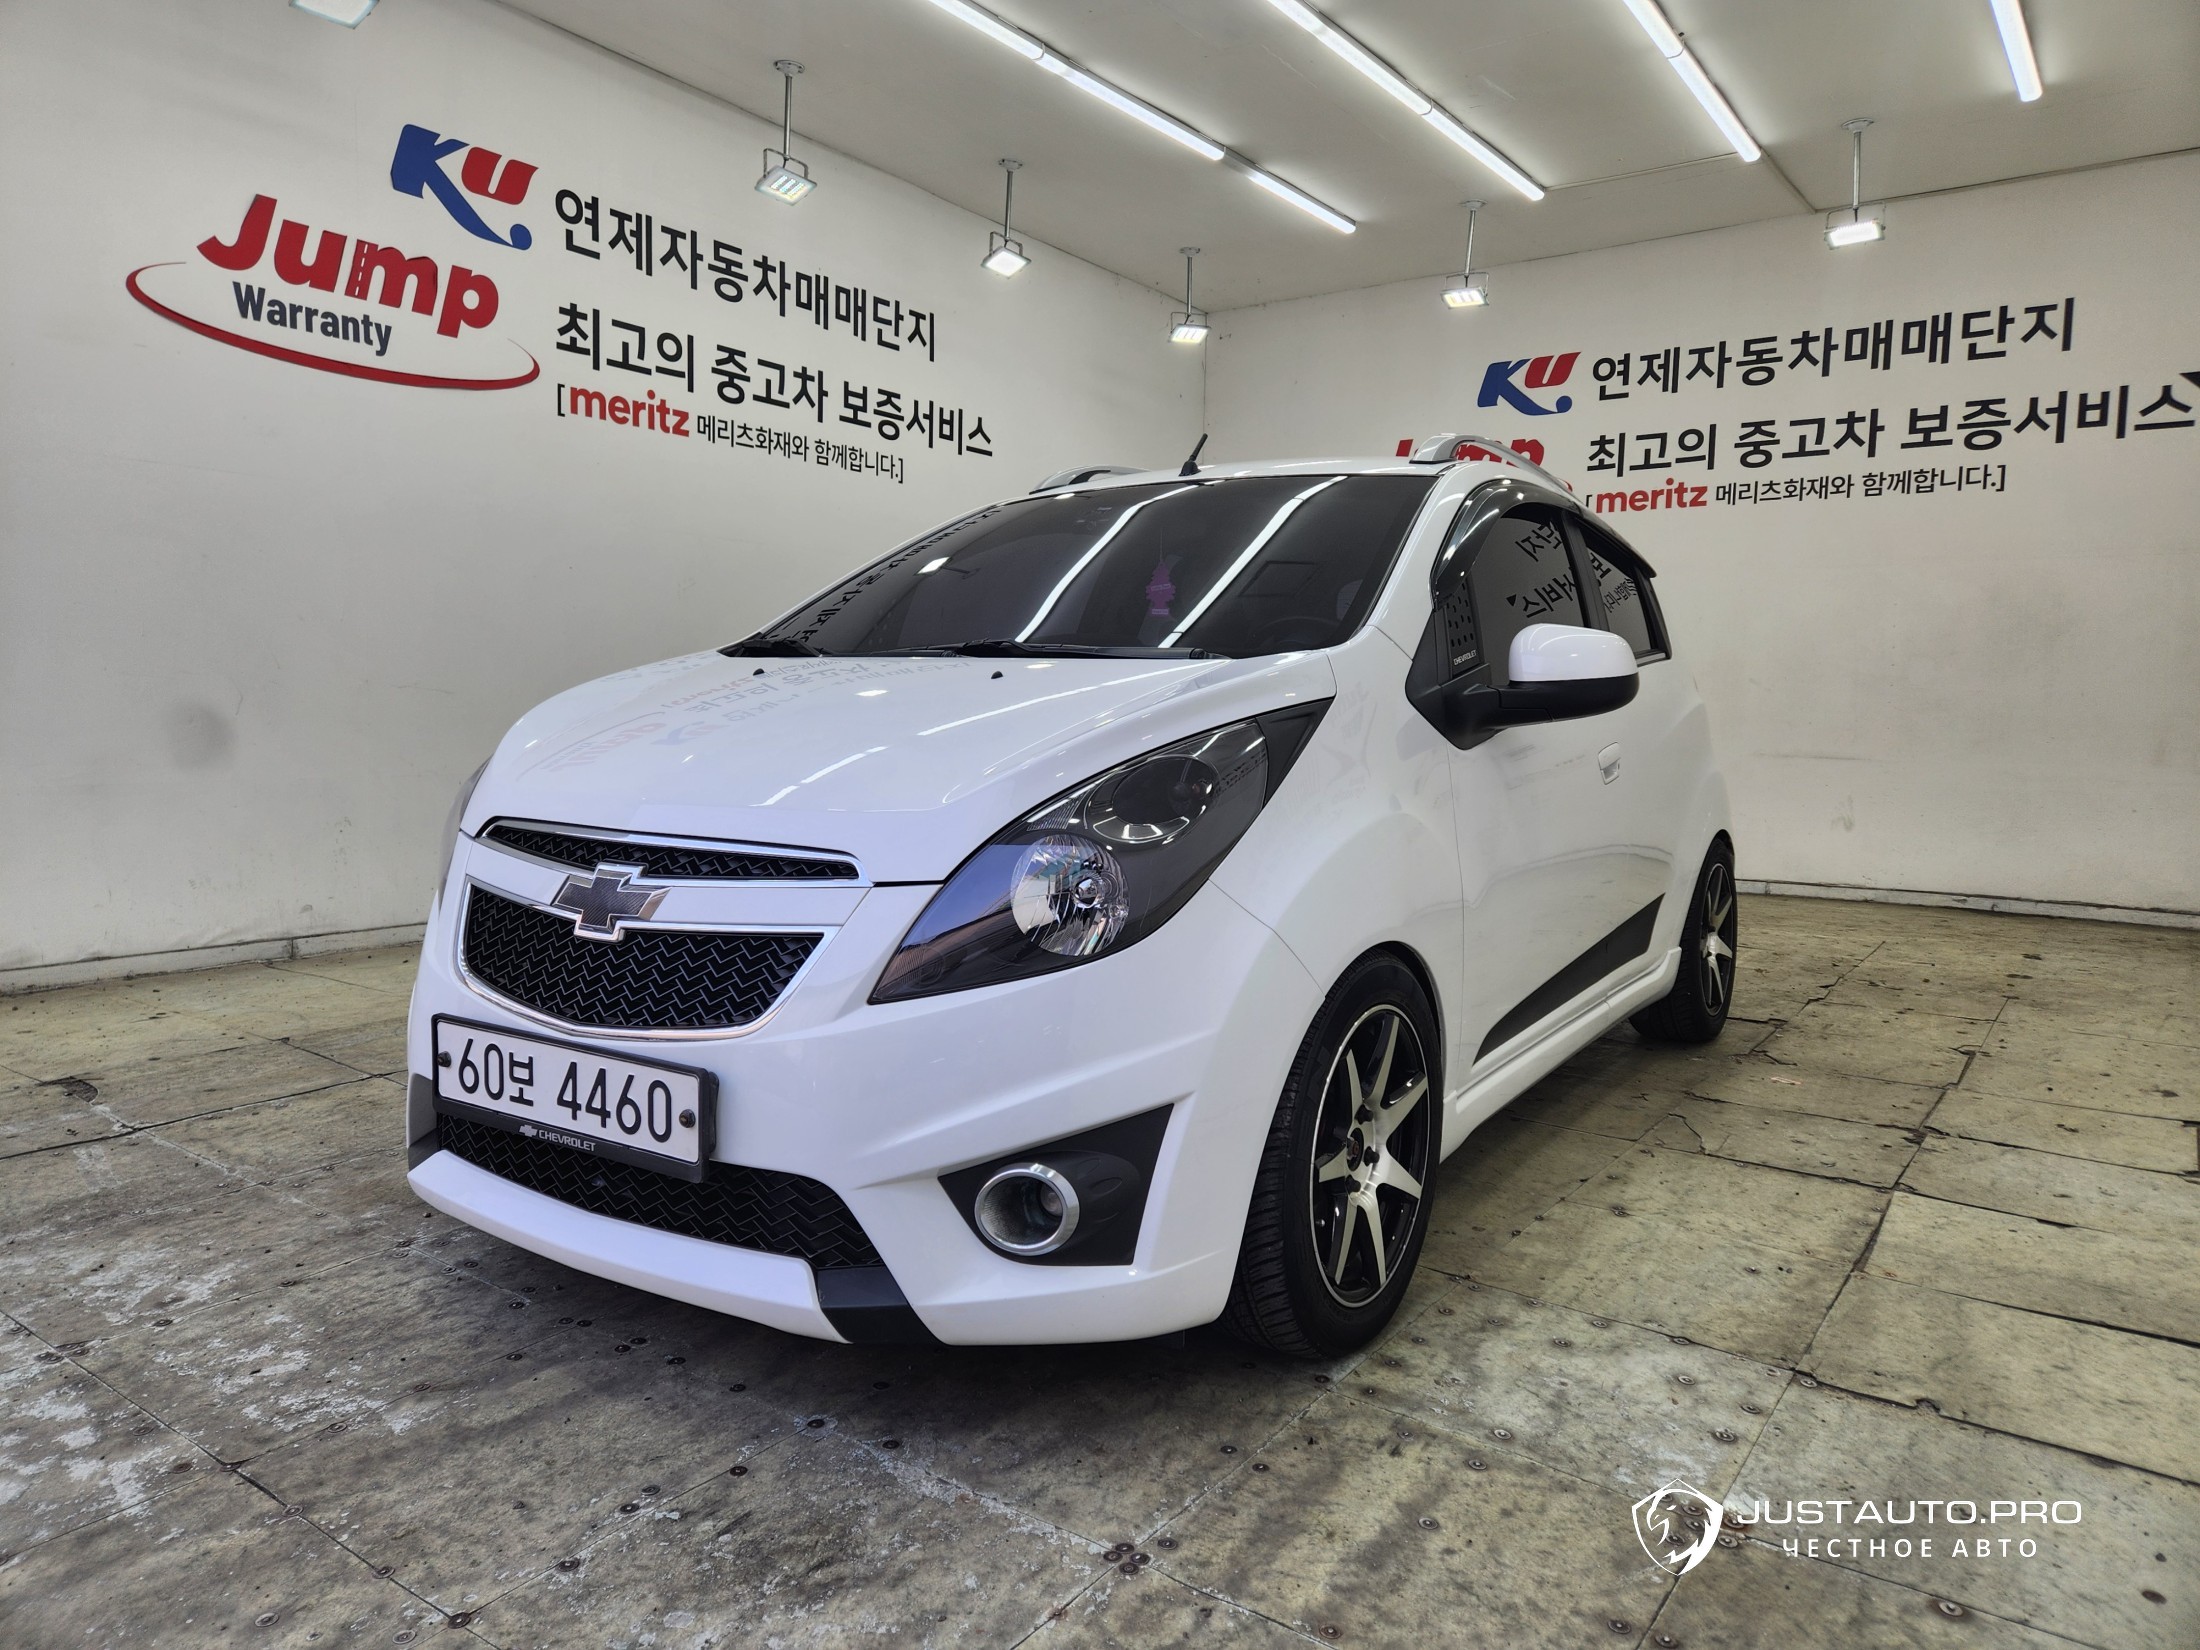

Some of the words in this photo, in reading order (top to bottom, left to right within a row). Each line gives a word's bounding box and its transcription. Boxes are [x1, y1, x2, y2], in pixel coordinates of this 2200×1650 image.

[197, 194, 499, 338] Jump
[555, 189, 936, 362] 연제자동차매매단지
[233, 281, 392, 356] Warranty
[1592, 297, 2075, 401] 연제자동차매매단지
[556, 303, 694, 392] 최고의
[711, 344, 828, 423] 중고차
[839, 381, 993, 457] 보증서비스
[697, 415, 810, 462] 메리츠화재와
[815, 439, 904, 484] 함께합니다.]
[1587, 424, 1718, 477] 최고의
[1734, 408, 1885, 468] 중고차
[1901, 385, 2196, 451] 보증서비스
[1715, 474, 1855, 506] 메리츠화재와
[1862, 464, 2007, 497] 함께합니다.]
[458, 1038, 534, 1107] 60보
[556, 1061, 672, 1143] 4460
[538, 1129, 596, 1152] CHEVROLET
